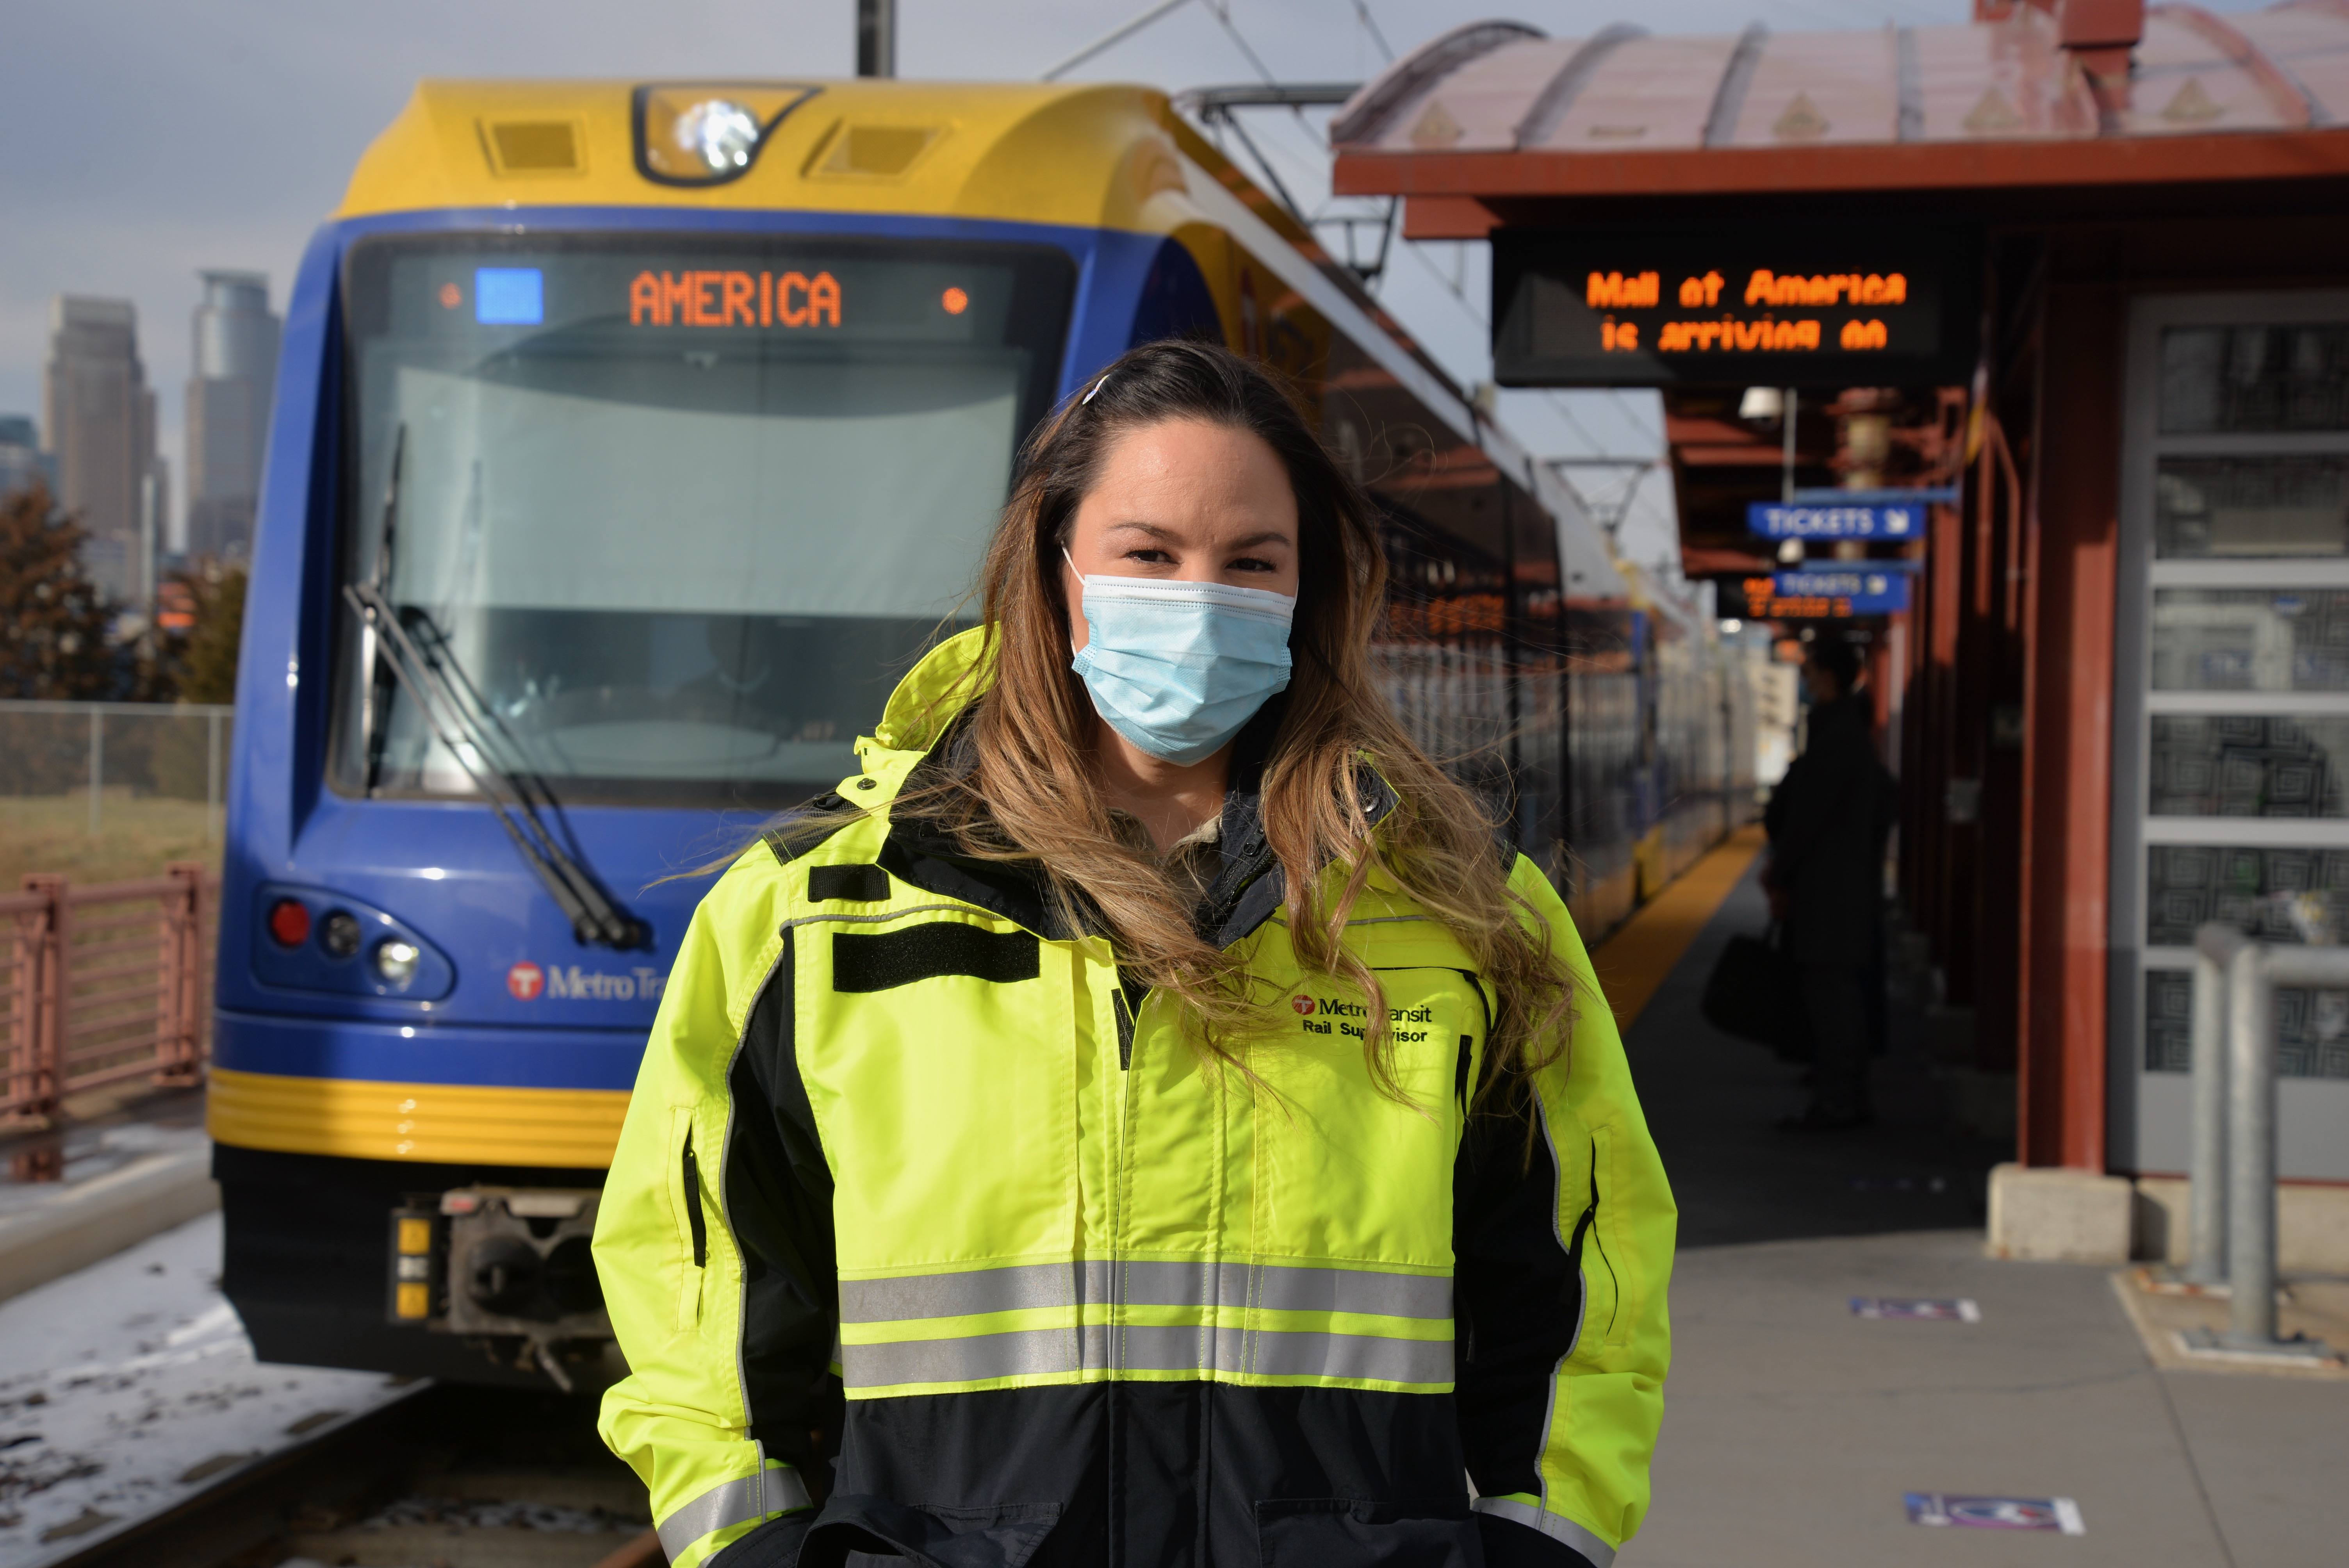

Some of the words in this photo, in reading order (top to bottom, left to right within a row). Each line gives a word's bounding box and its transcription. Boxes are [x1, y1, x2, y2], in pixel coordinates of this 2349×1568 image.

[630, 271, 841, 327] AMERICA
[1587, 271, 1659, 308] Mall
[1744, 269, 1907, 306] America
[1658, 313, 1821, 351] arriving
[1764, 508, 1874, 535] TICKETS
[1303, 1019, 1331, 1034] Rail
